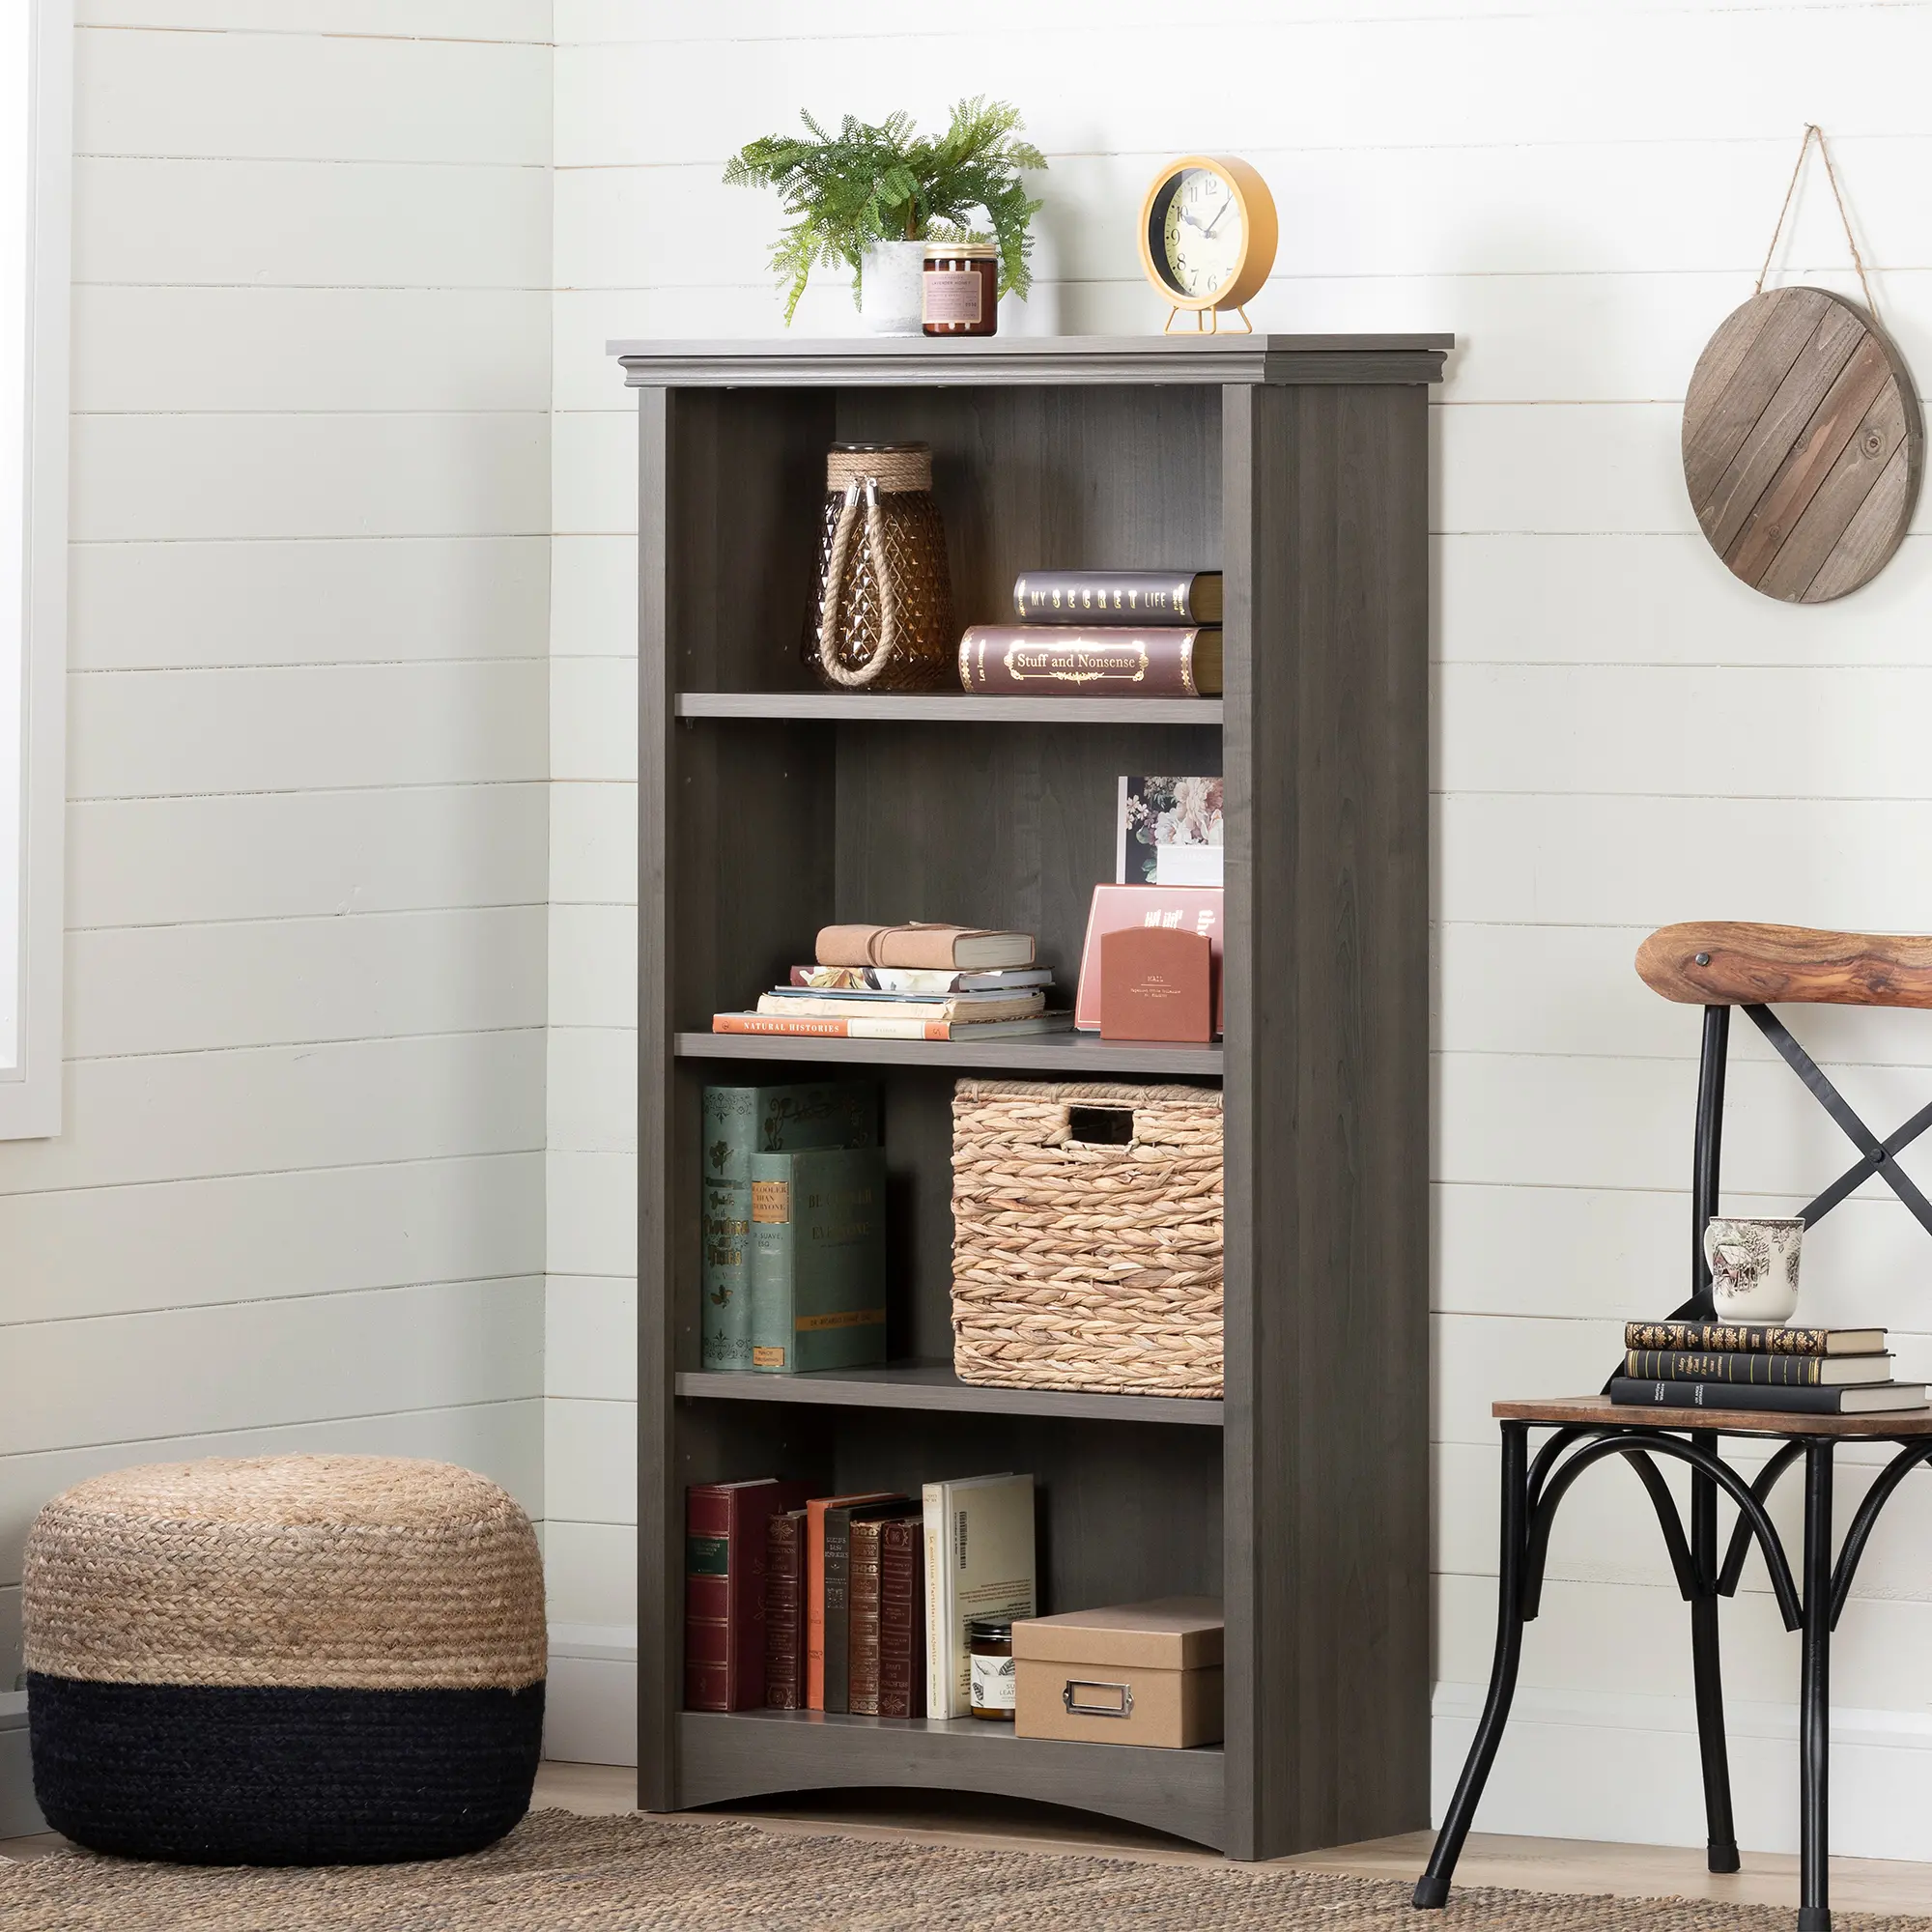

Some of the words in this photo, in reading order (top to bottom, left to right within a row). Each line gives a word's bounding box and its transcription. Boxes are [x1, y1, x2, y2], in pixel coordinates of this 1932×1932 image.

[1188, 186, 1198, 203] 11
[1205, 179, 1217, 196] 12
[1176, 204, 1189, 223] 10
[1171, 228, 1180, 247] 9
[1177, 252, 1187, 271] 8
[1190, 269, 1199, 287] 7
[1207, 273, 1218, 293] 6
[1031, 591, 1046, 607] MY
[1144, 592, 1167, 608] LIFE
[1017, 653, 1049, 668] Stuff
[1051, 654, 1075, 668] and
[1077, 653, 1136, 668] Nonsense
[744, 1022, 784, 1032] NATURAL
[788, 1023, 839, 1033] HISTORIES
[756, 1194, 776, 1203] THAN
[1678, 1356, 1687, 1373] Mary
[1686, 1354, 1694, 1376] Higgins
